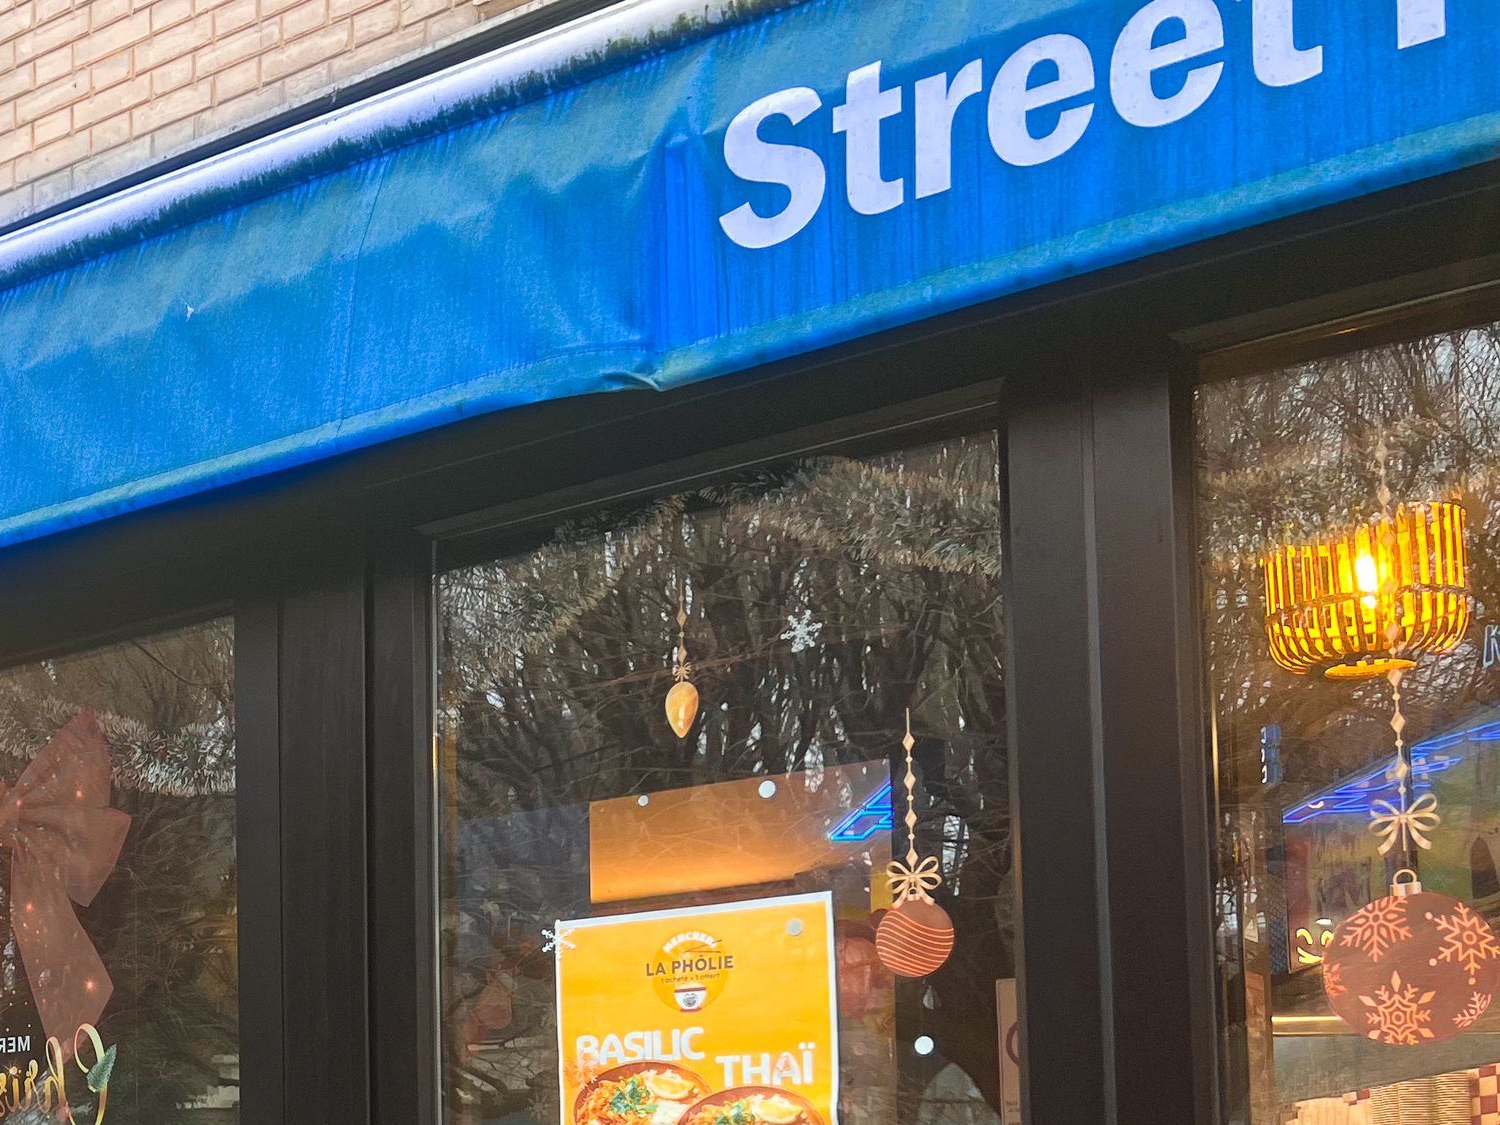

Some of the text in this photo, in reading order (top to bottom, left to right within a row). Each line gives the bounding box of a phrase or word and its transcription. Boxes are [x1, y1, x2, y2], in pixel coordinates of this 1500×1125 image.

[718, 0, 1324, 250] Street
[646, 954, 734, 977] LA PHÔLIE
[575, 1026, 706, 1067] BASILIC
[715, 1042, 816, 1087] THAÏ
